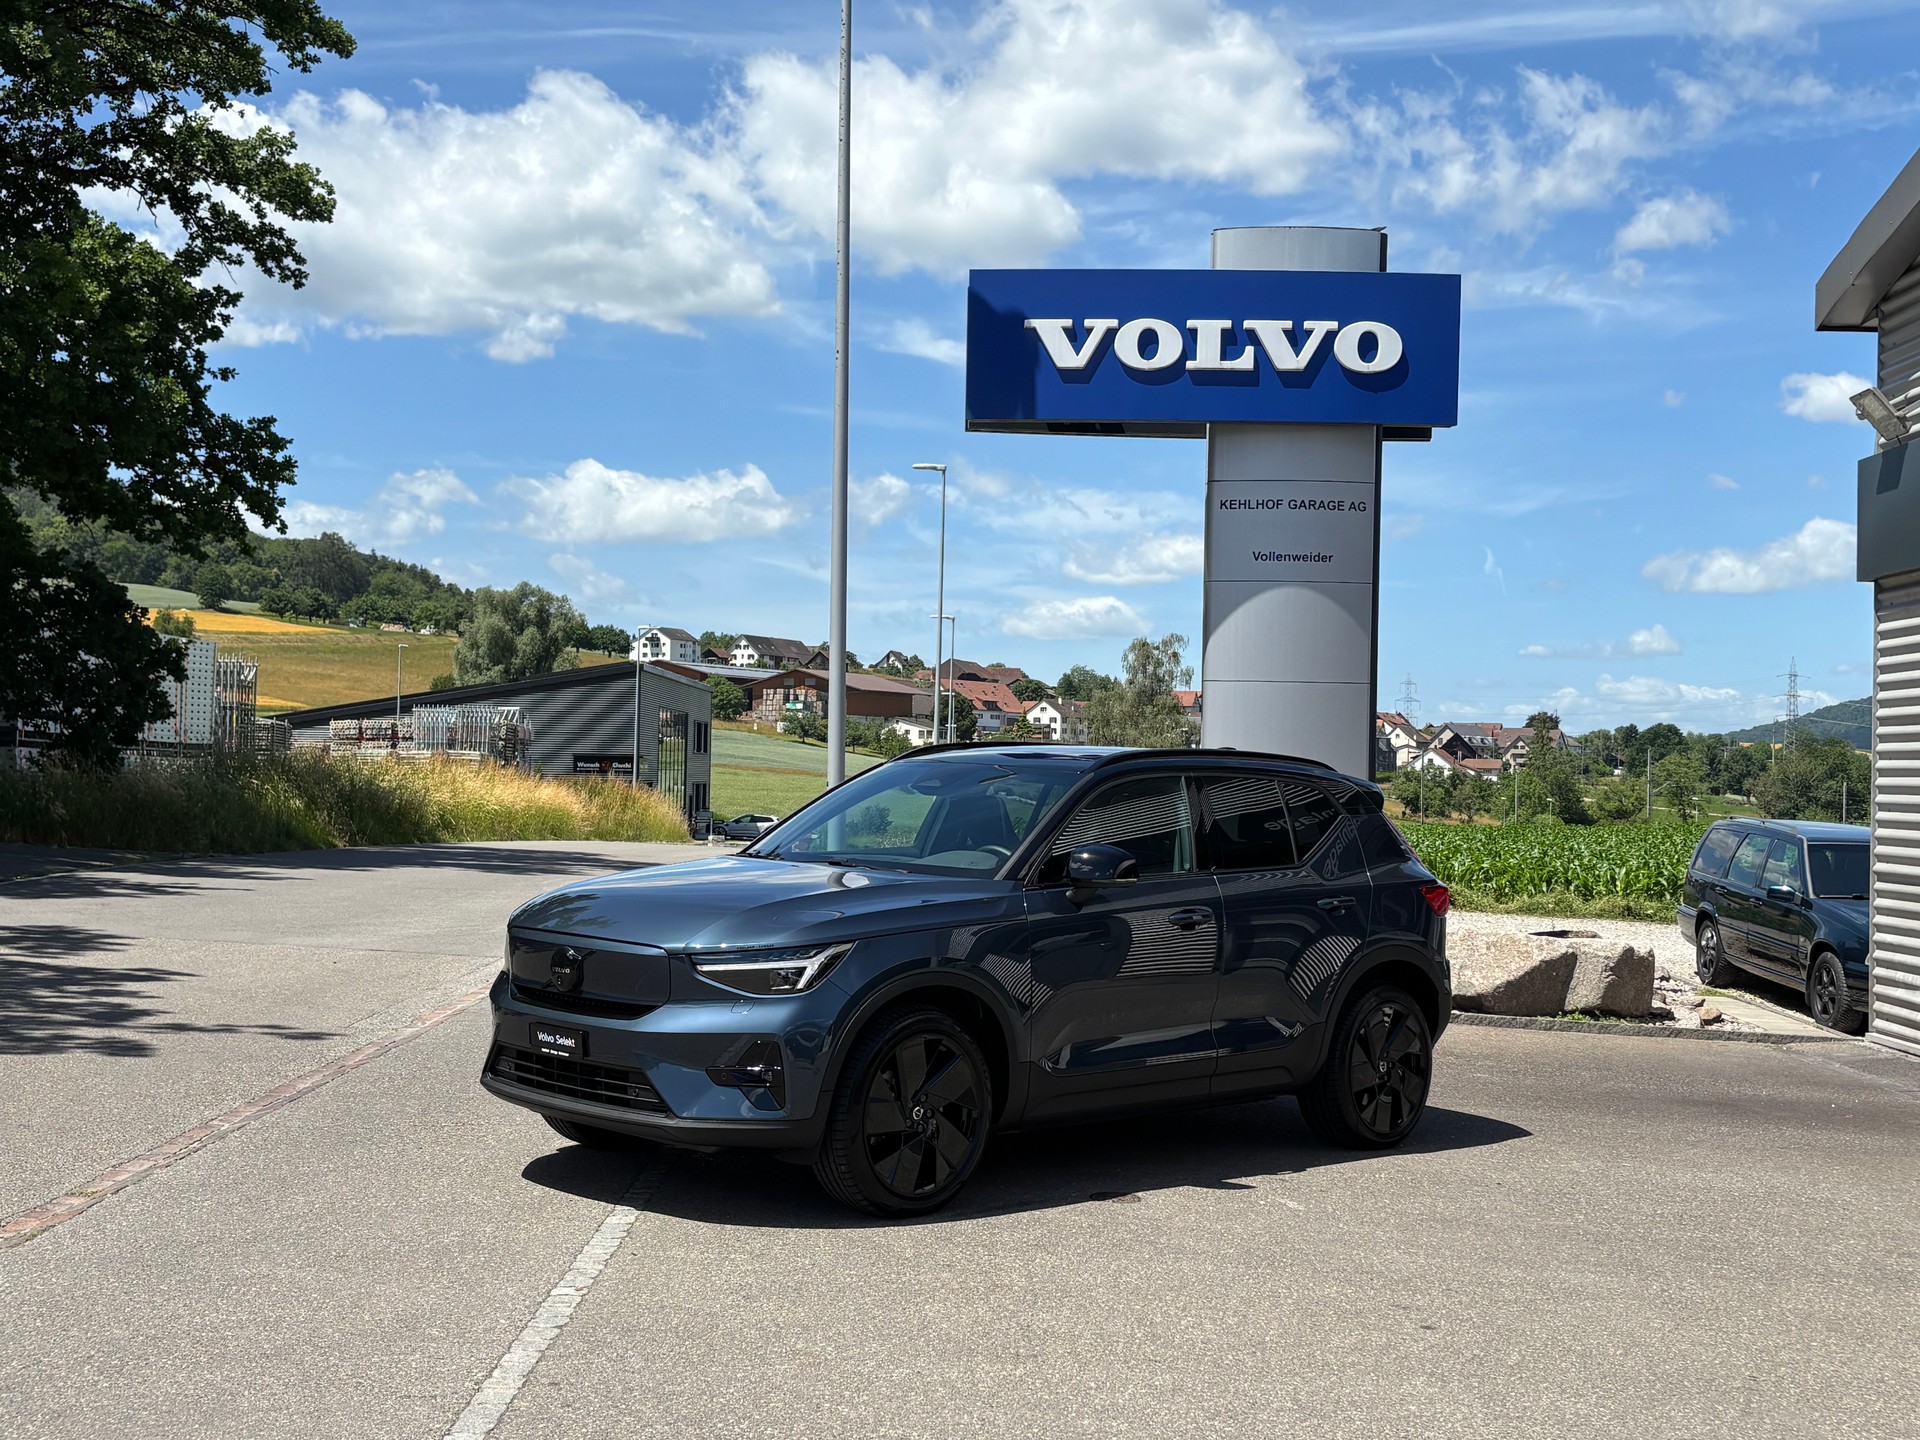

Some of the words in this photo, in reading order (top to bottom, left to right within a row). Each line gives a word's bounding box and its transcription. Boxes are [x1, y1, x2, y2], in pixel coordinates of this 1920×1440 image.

[1024, 318, 1403, 374] VOLVO
[1219, 499, 1284, 510] KEHLHOF
[1288, 499, 1345, 511] GARAGE
[1348, 501, 1367, 512] AG
[1252, 551, 1334, 563] Vollenweider
[536, 1031, 555, 1043] Volvo
[555, 1034, 576, 1048] Selekt
